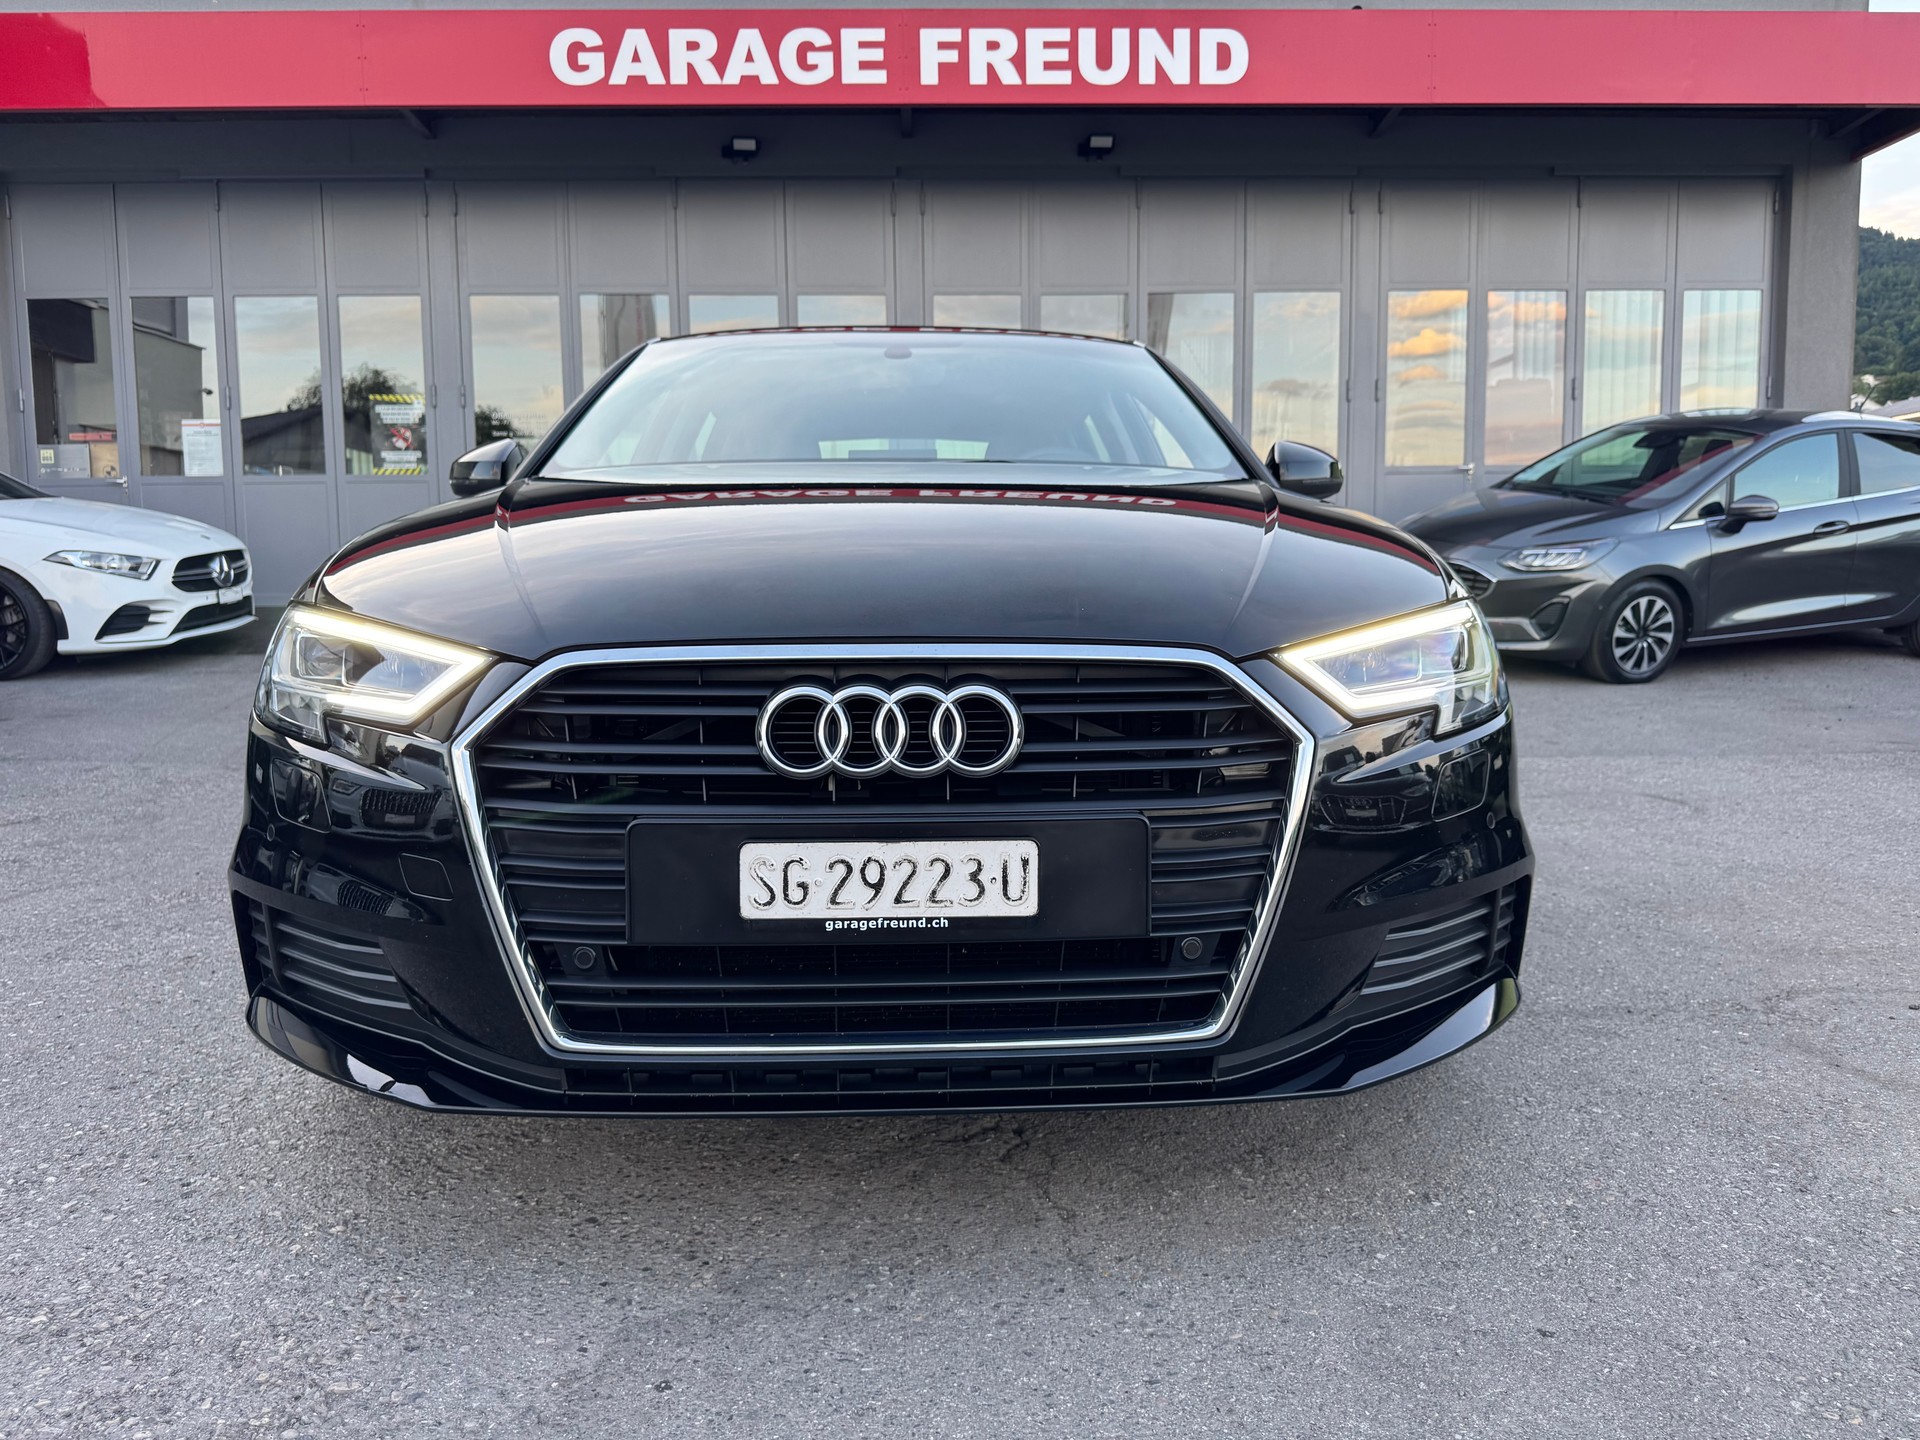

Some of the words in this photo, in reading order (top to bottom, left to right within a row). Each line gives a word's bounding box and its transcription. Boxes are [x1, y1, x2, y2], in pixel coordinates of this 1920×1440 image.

[549, 27, 888, 86] GARAGE
[919, 27, 1249, 86] FREUND
[825, 917, 949, 931] garagefreund.ch
